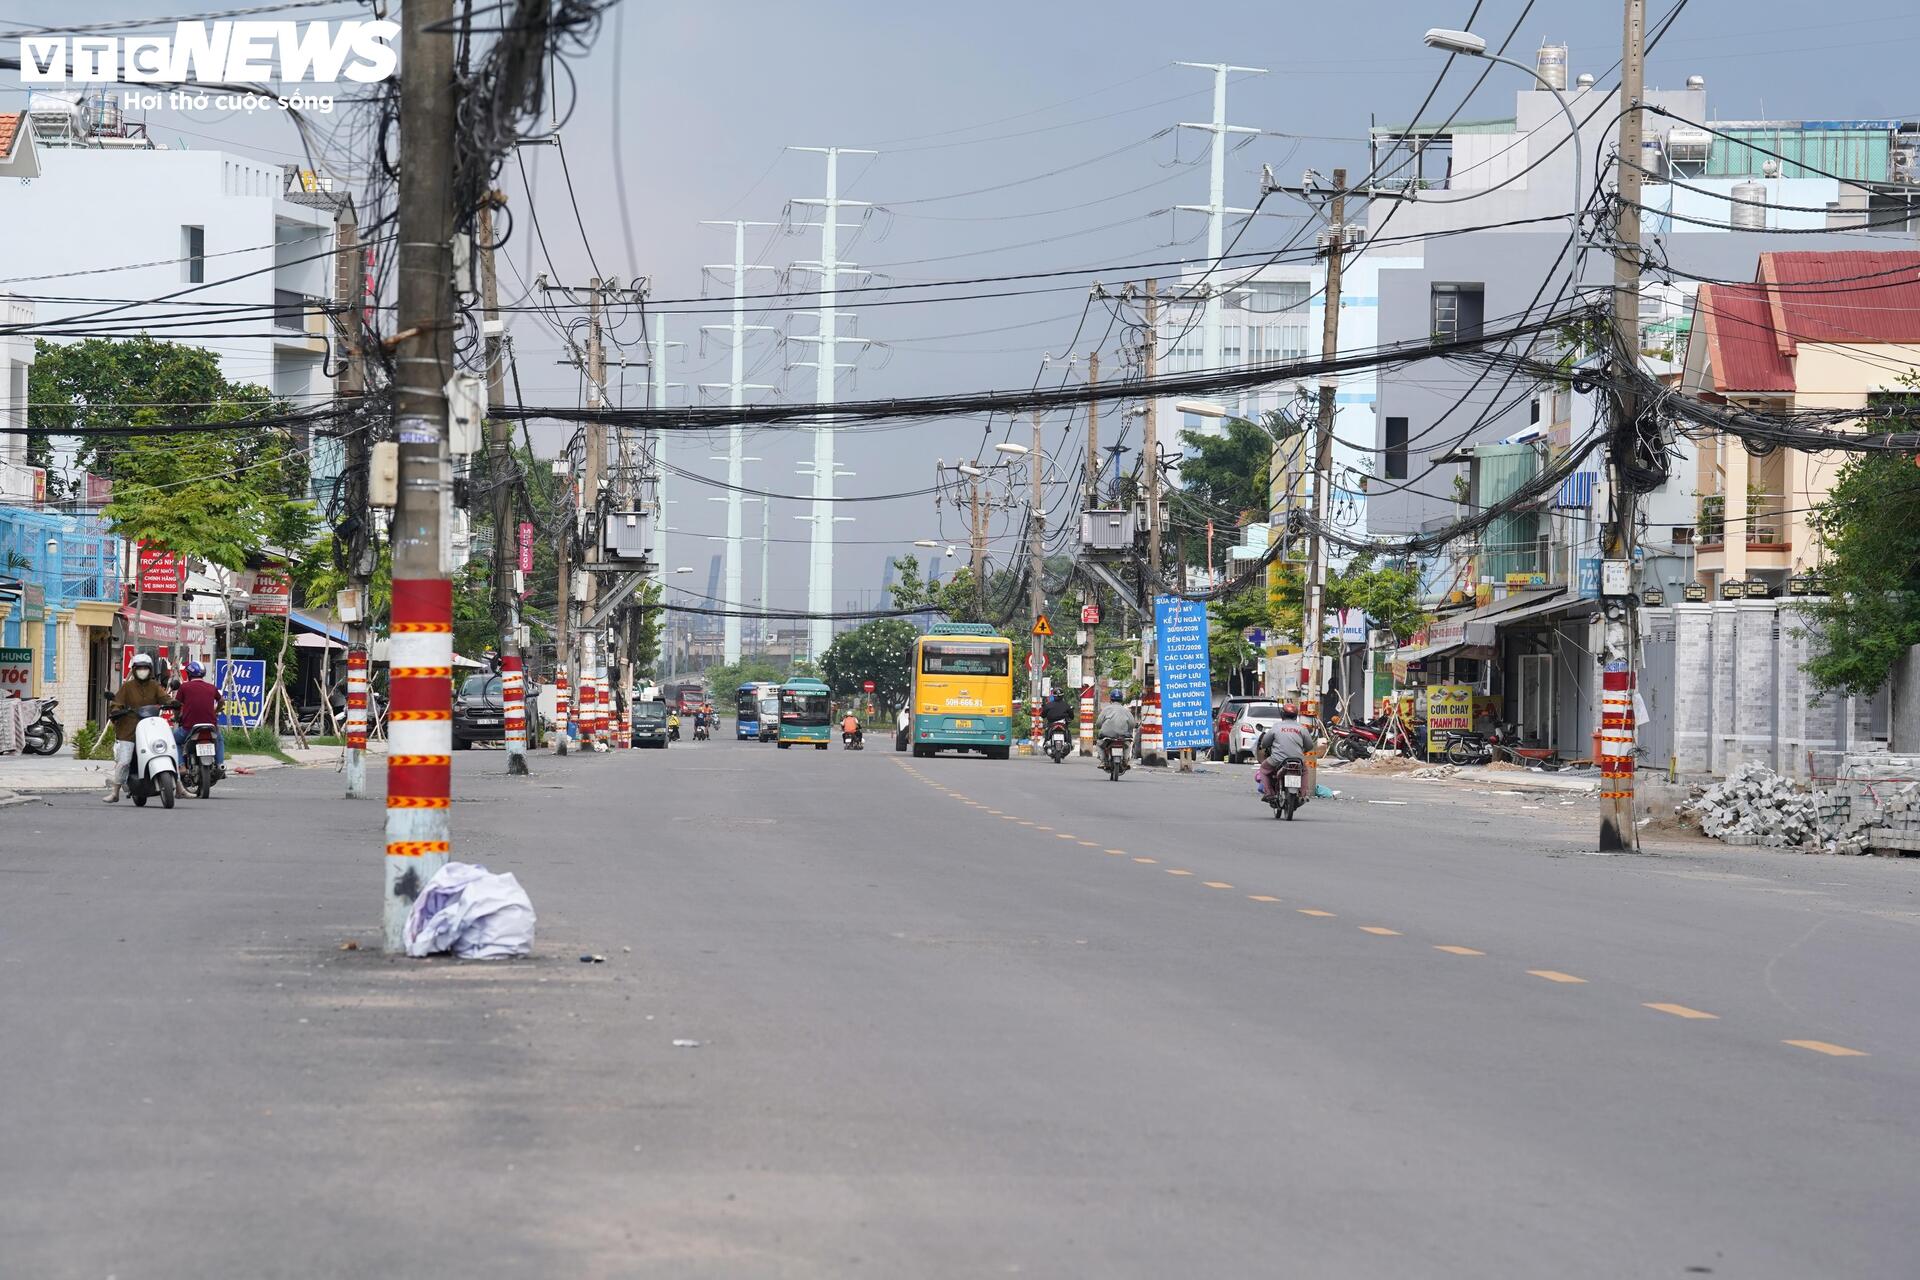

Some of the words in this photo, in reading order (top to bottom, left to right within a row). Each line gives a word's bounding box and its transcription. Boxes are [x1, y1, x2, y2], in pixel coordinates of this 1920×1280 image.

[1, 665, 29, 683] TÓC
[1450, 704, 1469, 715] CHAY
[1430, 717, 1453, 728] THANH
